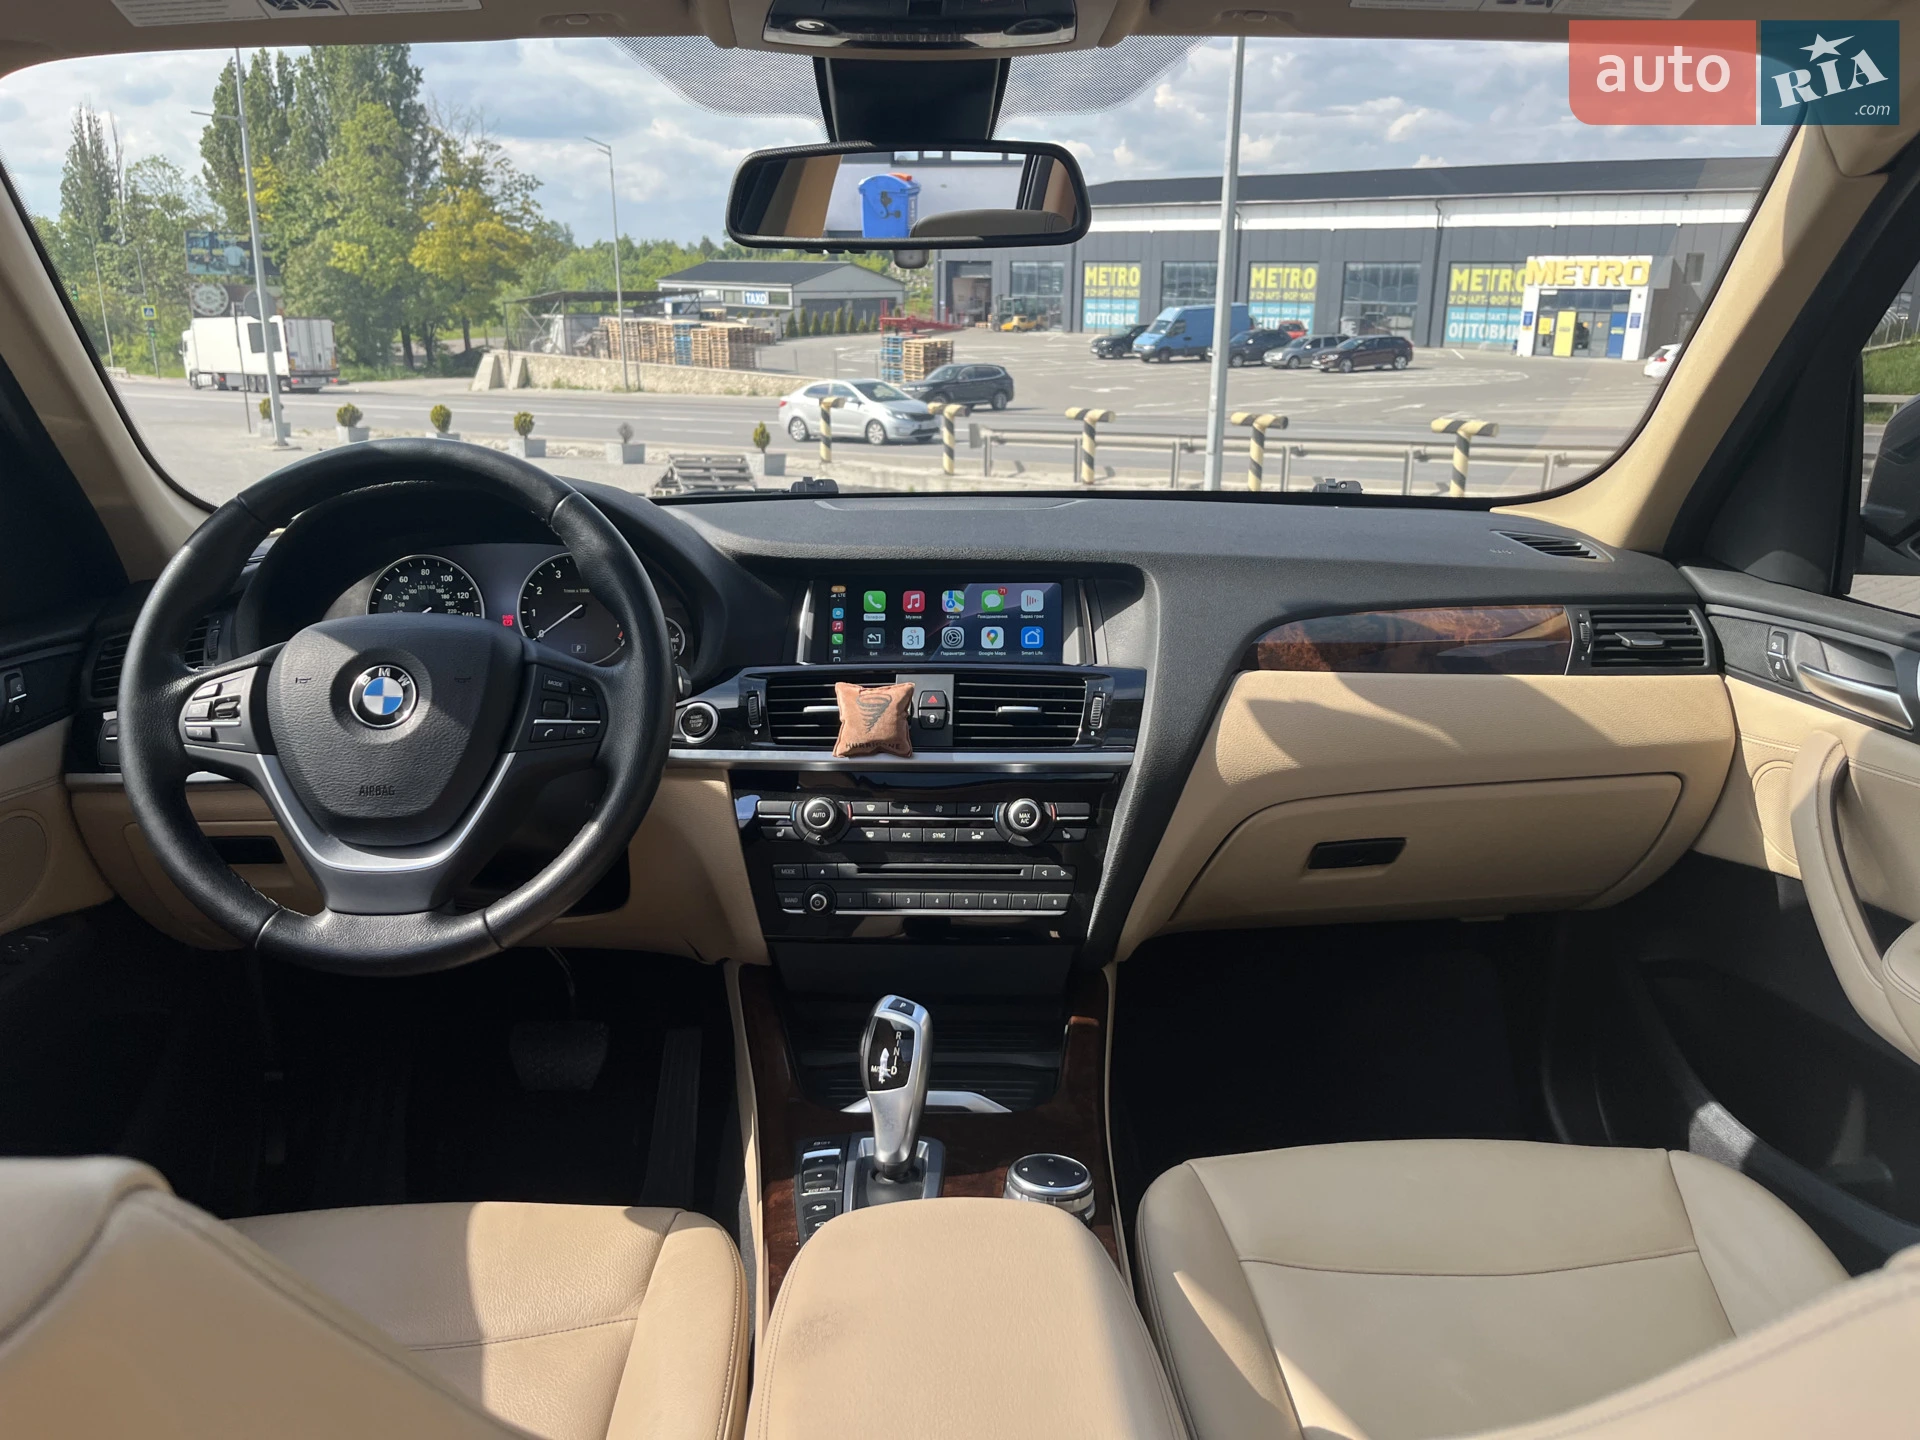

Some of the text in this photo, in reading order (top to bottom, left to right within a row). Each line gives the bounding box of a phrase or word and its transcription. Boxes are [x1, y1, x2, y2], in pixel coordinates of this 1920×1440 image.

[1085, 266, 1140, 287] METRO
[1251, 267, 1317, 290] METRO
[1525, 260, 1650, 287] METRO
[555, 570, 562, 578] 3
[536, 586, 543, 595] 2
[532, 609, 536, 617] 1
[906, 634, 920, 646] 31
[359, 667, 411, 687] BMW
[359, 785, 395, 796] AIRBAG
[895, 1031, 902, 1040] R
[893, 1046, 900, 1056] N
[890, 1066, 898, 1075] D
